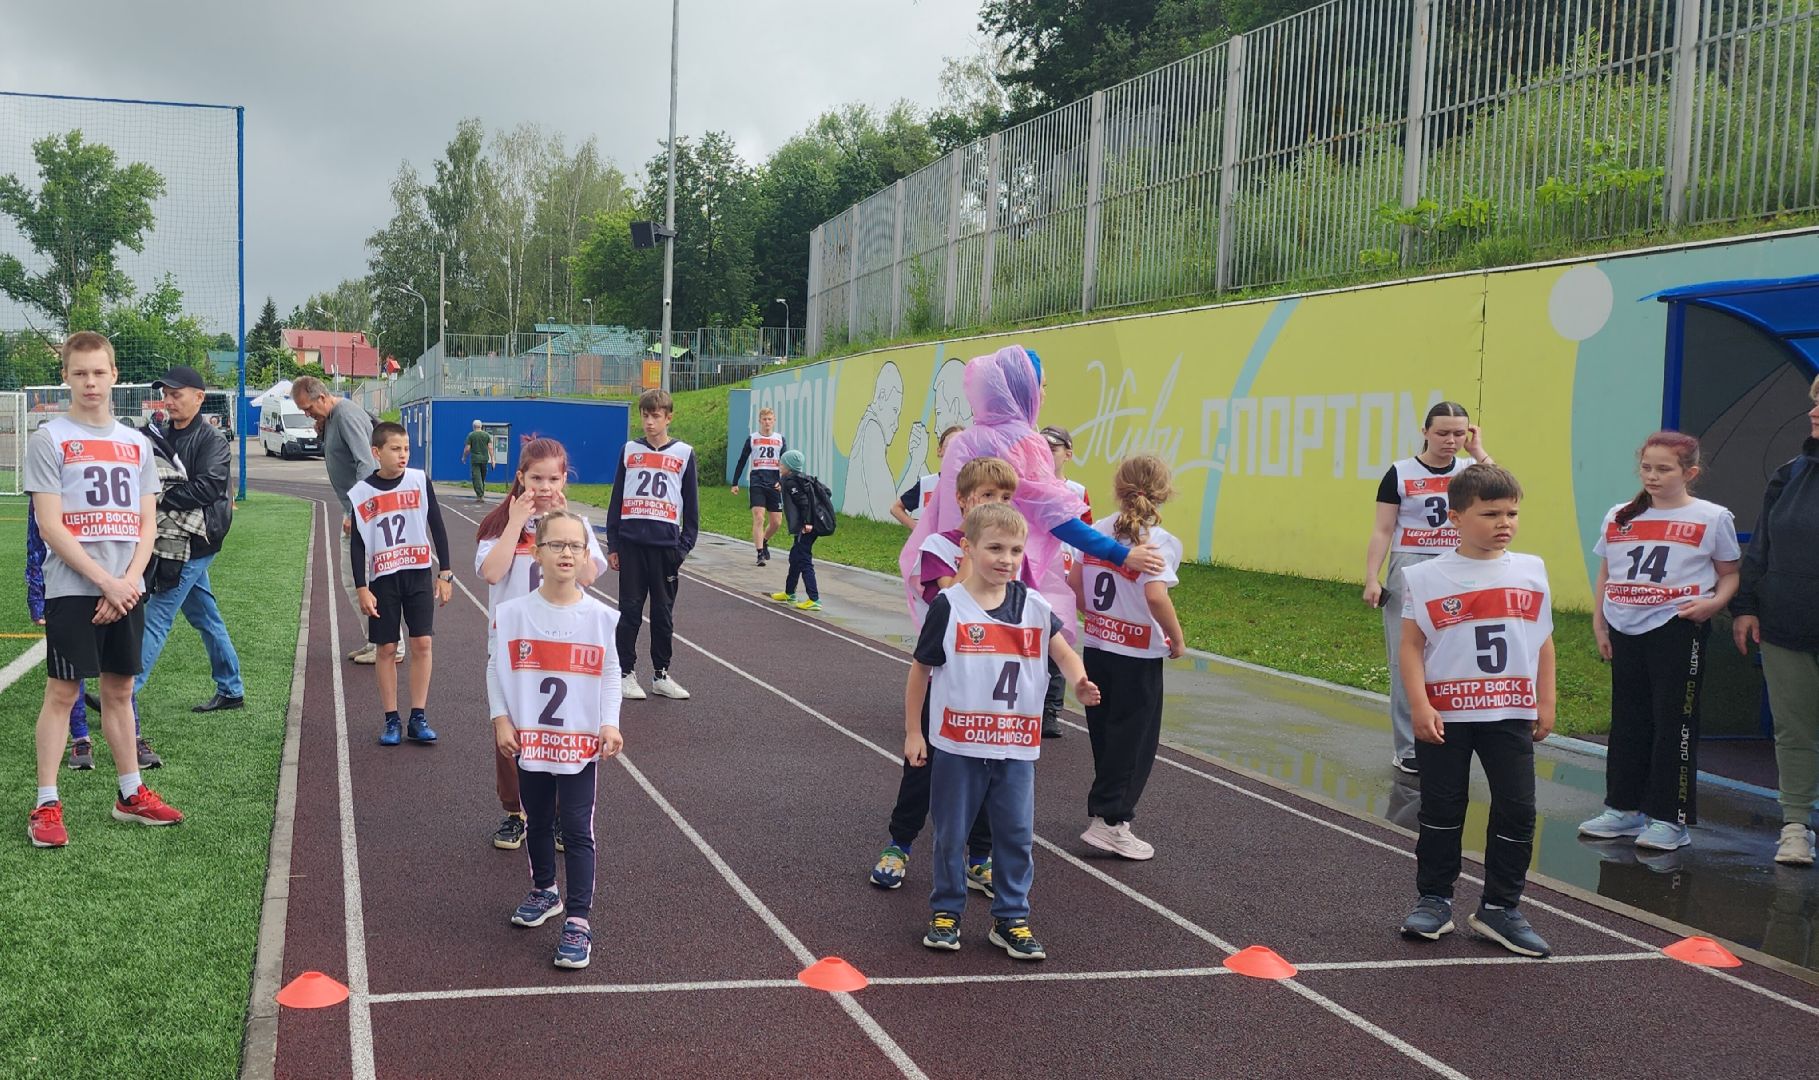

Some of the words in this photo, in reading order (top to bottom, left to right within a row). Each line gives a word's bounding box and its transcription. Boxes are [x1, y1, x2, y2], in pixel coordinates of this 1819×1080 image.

[759, 446, 775, 459] 28
[83, 466, 132, 508] 36
[636, 470, 668, 499] 26
[396, 491, 416, 505] ГТО
[65, 512, 104, 525] ЦЕНТР
[105, 511, 134, 524] ВФСК
[1424, 496, 1448, 528] 3
[376, 513, 406, 548] 12
[1440, 529, 1462, 537] ВФС
[1665, 523, 1697, 537] ГТО
[1417, 537, 1462, 548] ОДИНЦО
[411, 547, 427, 556] ГТО
[1626, 545, 1671, 583] 14
[1092, 571, 1117, 612] 9
[1121, 623, 1144, 636] ГТО
[570, 644, 600, 667] ГТО
[1474, 624, 1508, 674] 5
[992, 660, 1021, 710] 4
[1433, 681, 1482, 696] ЦЕНТР
[1483, 679, 1522, 693] ВФСК
[537, 676, 568, 727] 2
[1451, 693, 1534, 710] ОДИНЦОВО
[948, 714, 994, 728] ЦЕНТР
[541, 732, 577, 747] ВФСК
